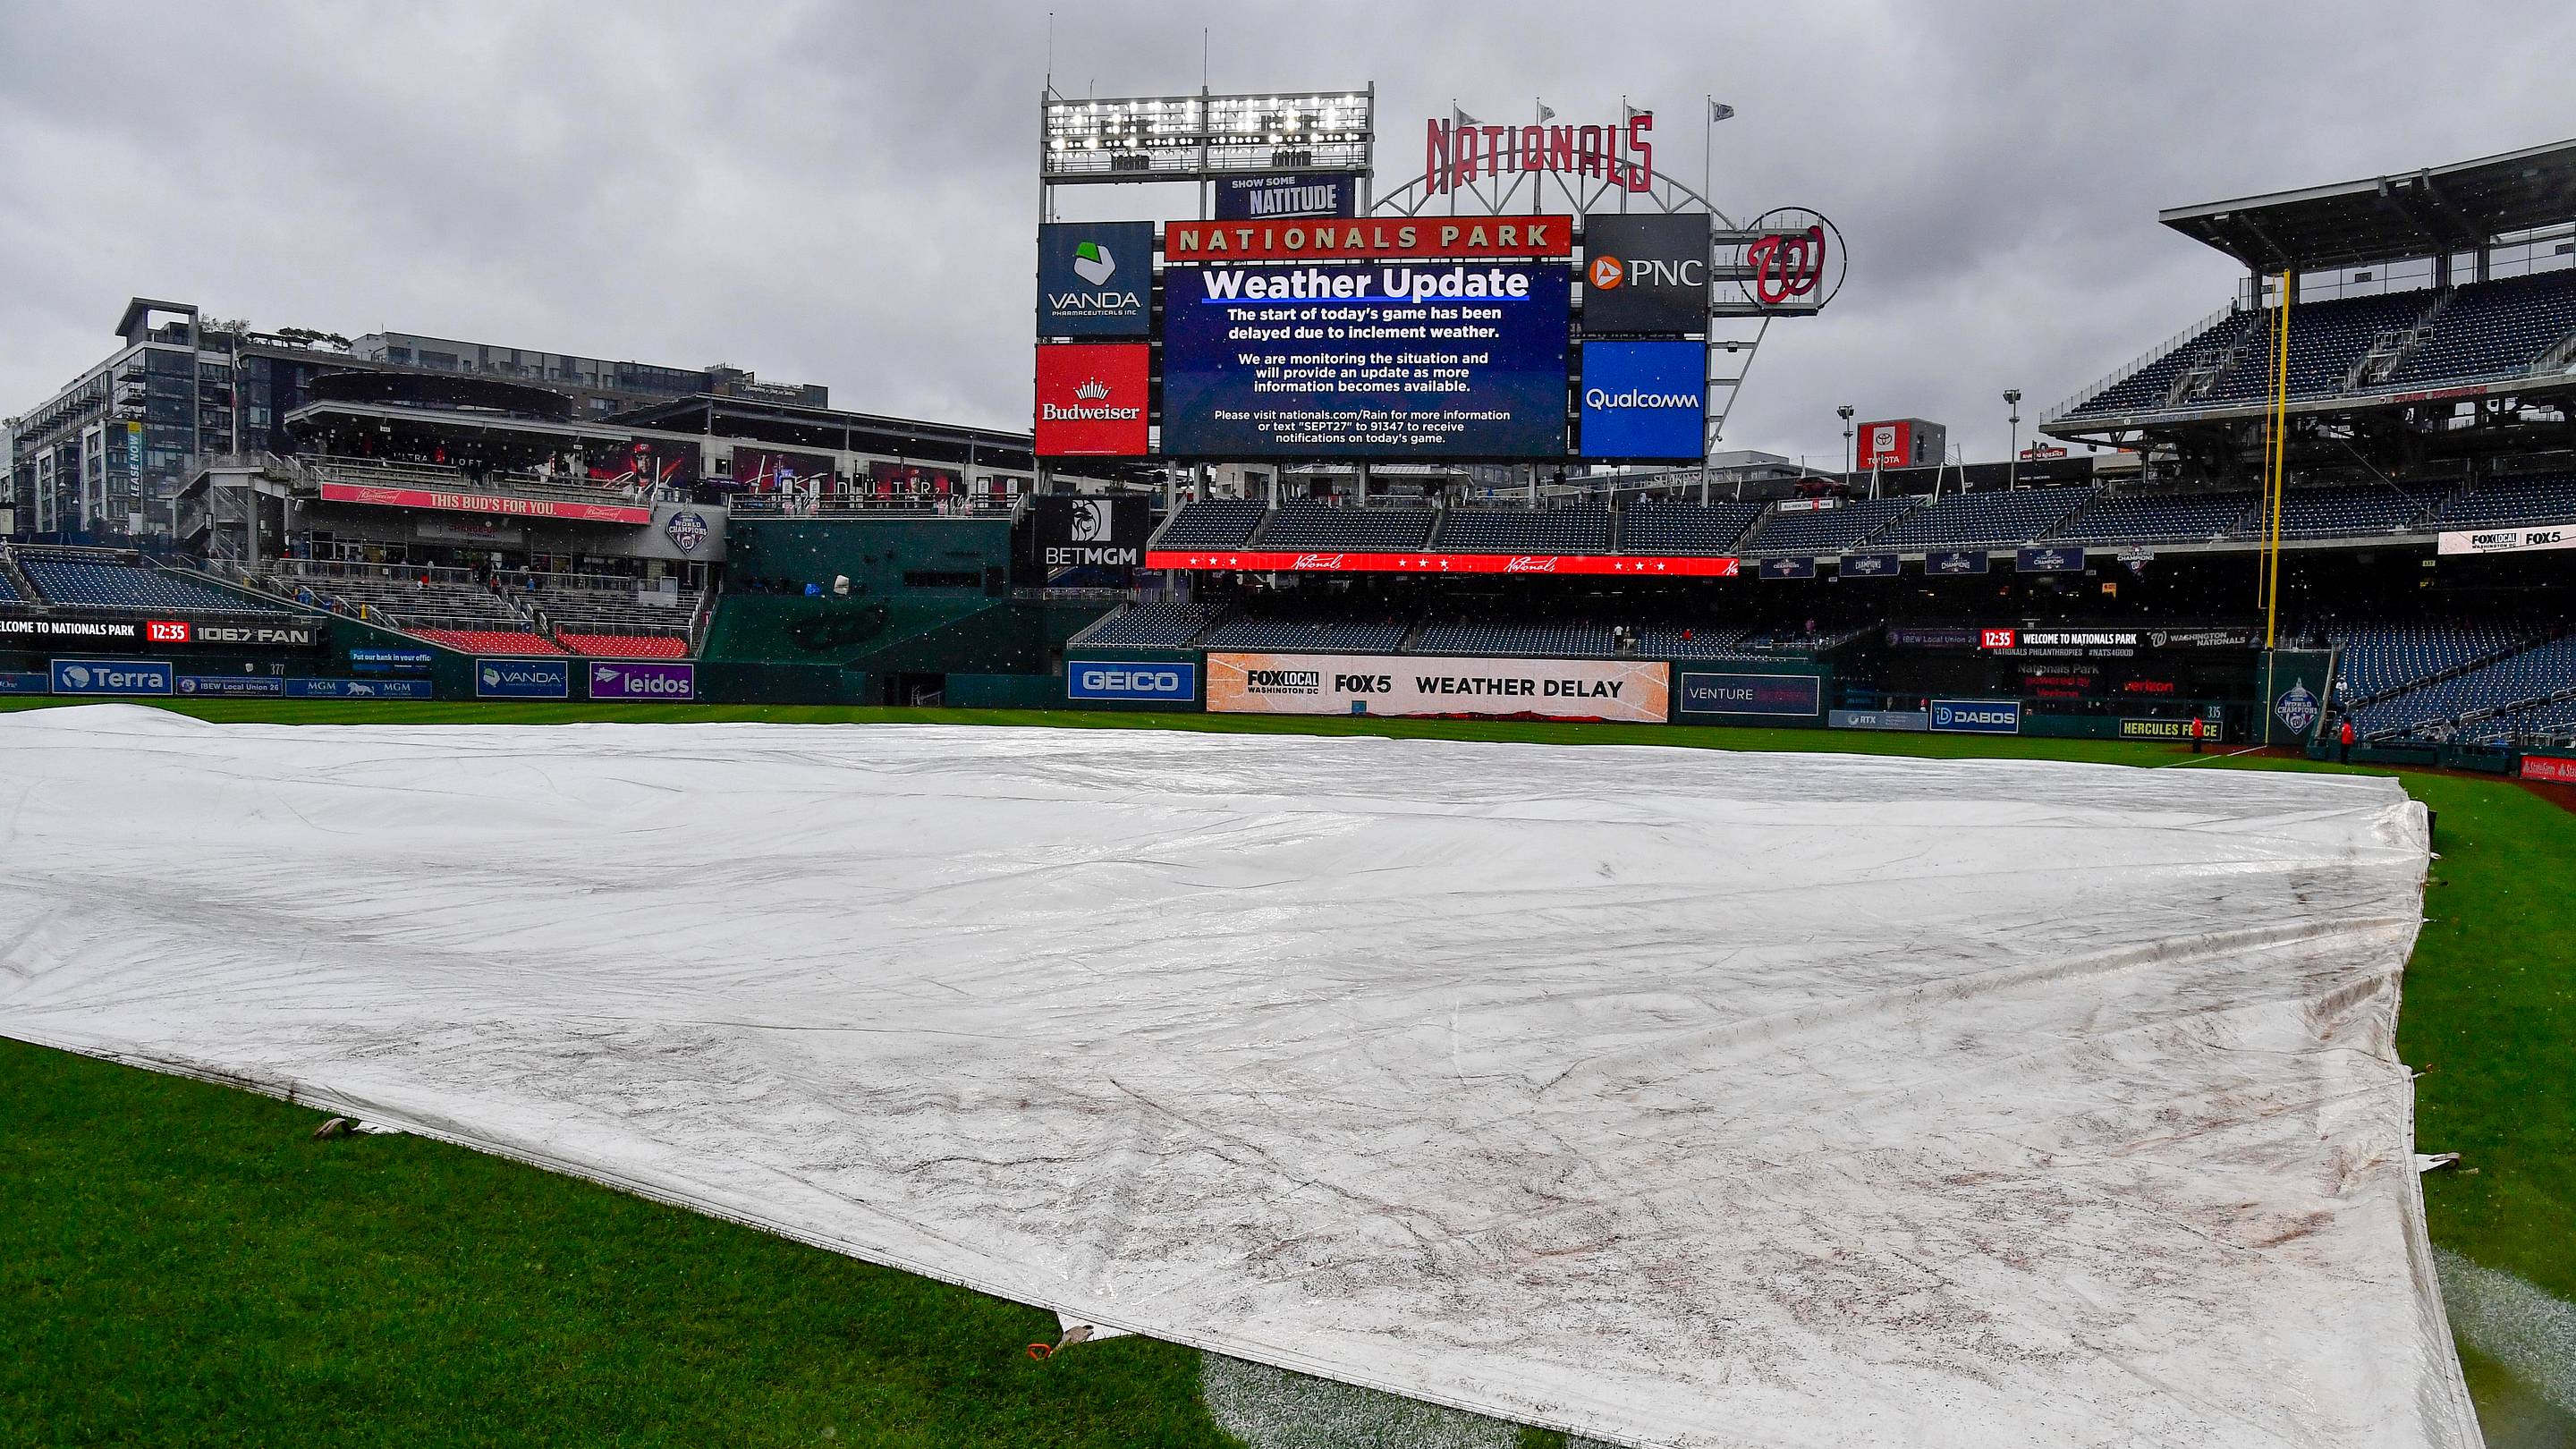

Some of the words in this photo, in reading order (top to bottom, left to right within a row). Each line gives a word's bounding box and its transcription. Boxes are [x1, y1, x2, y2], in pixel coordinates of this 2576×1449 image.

[1426, 114, 1653, 195] NATIONALS
[1231, 178, 1264, 189] SHOW
[1266, 175, 1296, 186] SOME
[1250, 183, 1337, 215] NATITUDE
[1179, 226, 1418, 251] NATIONALS
[1440, 225, 1548, 247] PARK
[1627, 258, 1704, 287] PNC
[1202, 268, 1372, 300] Weather
[1383, 267, 1530, 303] Update
[1047, 292, 1142, 310] VANDA
[1226, 308, 1257, 321] The
[1259, 308, 1297, 321] start
[1300, 307, 1318, 320] of
[1320, 307, 1379, 324] today's
[1382, 309, 1427, 323] game
[1430, 306, 1458, 319] has
[1462, 306, 1502, 319] been
[1228, 326, 1291, 342] delayed
[1293, 326, 1324, 339] due
[1327, 326, 1345, 339] to
[1348, 325, 1427, 339] inclement
[1429, 325, 1500, 338] weather.
[1238, 353, 1261, 365] We
[1264, 355, 1286, 365] are
[1290, 352, 1366, 367] monitoring
[1369, 352, 1393, 364] the
[1396, 352, 1458, 364] situation
[1462, 352, 1488, 364] and
[1255, 366, 1280, 378] will
[1284, 366, 1336, 381] provide
[1340, 369, 1357, 378] an
[1360, 366, 1410, 380] update
[1413, 369, 1429, 378] as
[1433, 369, 1470, 378] more
[1254, 380, 1335, 393] information
[1337, 380, 1401, 393] becomes
[1403, 379, 1470, 392] available.
[1585, 387, 1699, 411] Qualcomm
[1041, 403, 1140, 420] Budweiser
[1215, 410, 1250, 420] Please
[1253, 410, 1277, 420] visit
[1279, 410, 1388, 421] nationals.com/Rain
[1390, 410, 1408, 420] for
[1410, 411, 1441, 420] more
[1443, 410, 1511, 420] information
[1258, 423, 1271, 431] or
[1273, 421, 1296, 431] text
[1299, 421, 1352, 431] "SEPT27"
[1355, 421, 1368, 431] to
[1370, 421, 1404, 431] 91347
[1407, 421, 1419, 431] to
[1422, 421, 1465, 432] receive
[1275, 432, 1346, 443] notifications
[1348, 435, 1363, 443] on
[1365, 432, 1408, 445] today's
[1410, 435, 1446, 445] game.
[130, 435, 139, 462] NOW
[131, 464, 140, 497] LEASE
[429, 493, 460, 508] THIS
[462, 496, 500, 512] BUD'S
[503, 499, 527, 514] FOR
[529, 501, 557, 516] YOU.
[668, 525, 708, 536] CHAMPIONS
[674, 520, 702, 528] WORLD
[2471, 534, 2496, 545] FOX
[2495, 533, 2517, 544] LOCAL
[2526, 532, 2550, 544] FOX
[2551, 531, 2561, 542] 5
[1046, 547, 1138, 565] BETMGM
[1292, 554, 1343, 572] Nationals
[1504, 555, 1555, 573] Nationals
[36, 621, 49, 634] TO
[51, 622, 107, 636] NATIONALS
[108, 623, 135, 637] PARK
[151, 623, 186, 640] 12:35
[258, 628, 309, 643] FAN
[2170, 631, 2228, 641] WASHINGTON
[1984, 631, 2012, 647] 12:35
[2022, 633, 2059, 645] WELCOME
[2060, 633, 2071, 645] TO
[2071, 632, 2114, 645] NATIONALS
[2114, 632, 2137, 645] PARK
[2196, 636, 2246, 647] NATIONALS
[352, 653, 364, 661] Put
[376, 653, 393, 661] bank
[393, 653, 400, 661] in
[1993, 648, 2028, 657] NATIONALS
[2029, 648, 2083, 657] PHILANTHROPIES
[270, 663, 285, 676] 377
[2017, 664, 2070, 674] Nationals
[2072, 664, 2100, 674] Park
[93, 668, 164, 688] Terra
[500, 672, 562, 684] VANDA
[623, 673, 691, 694] leidos
[1082, 671, 1179, 691] GEICO
[1247, 670, 1283, 686] FOX
[1283, 671, 1319, 686] LOCAL
[1335, 674, 1376, 693] FOX
[1376, 674, 1392, 693] 5
[223, 682, 244, 691] Local
[246, 683, 268, 691] Union
[308, 681, 337, 691] MGM
[383, 682, 411, 691] MGM
[1247, 686, 1305, 695] WASHINGTON
[1306, 687, 1319, 695] DC
[1415, 676, 1536, 697] WEATHER
[1543, 679, 1624, 699] DELAY
[1689, 687, 1754, 700] VENTURE
[2277, 706, 2318, 715] CHAMPIONS
[2284, 699, 2312, 708] WORLD
[1954, 711, 2016, 724] DABOS
[2207, 706, 2222, 718] 335
[1860, 716, 1877, 724] RTX
[2123, 722, 2179, 736] HERCULES
[2182, 724, 2218, 737] FECE
